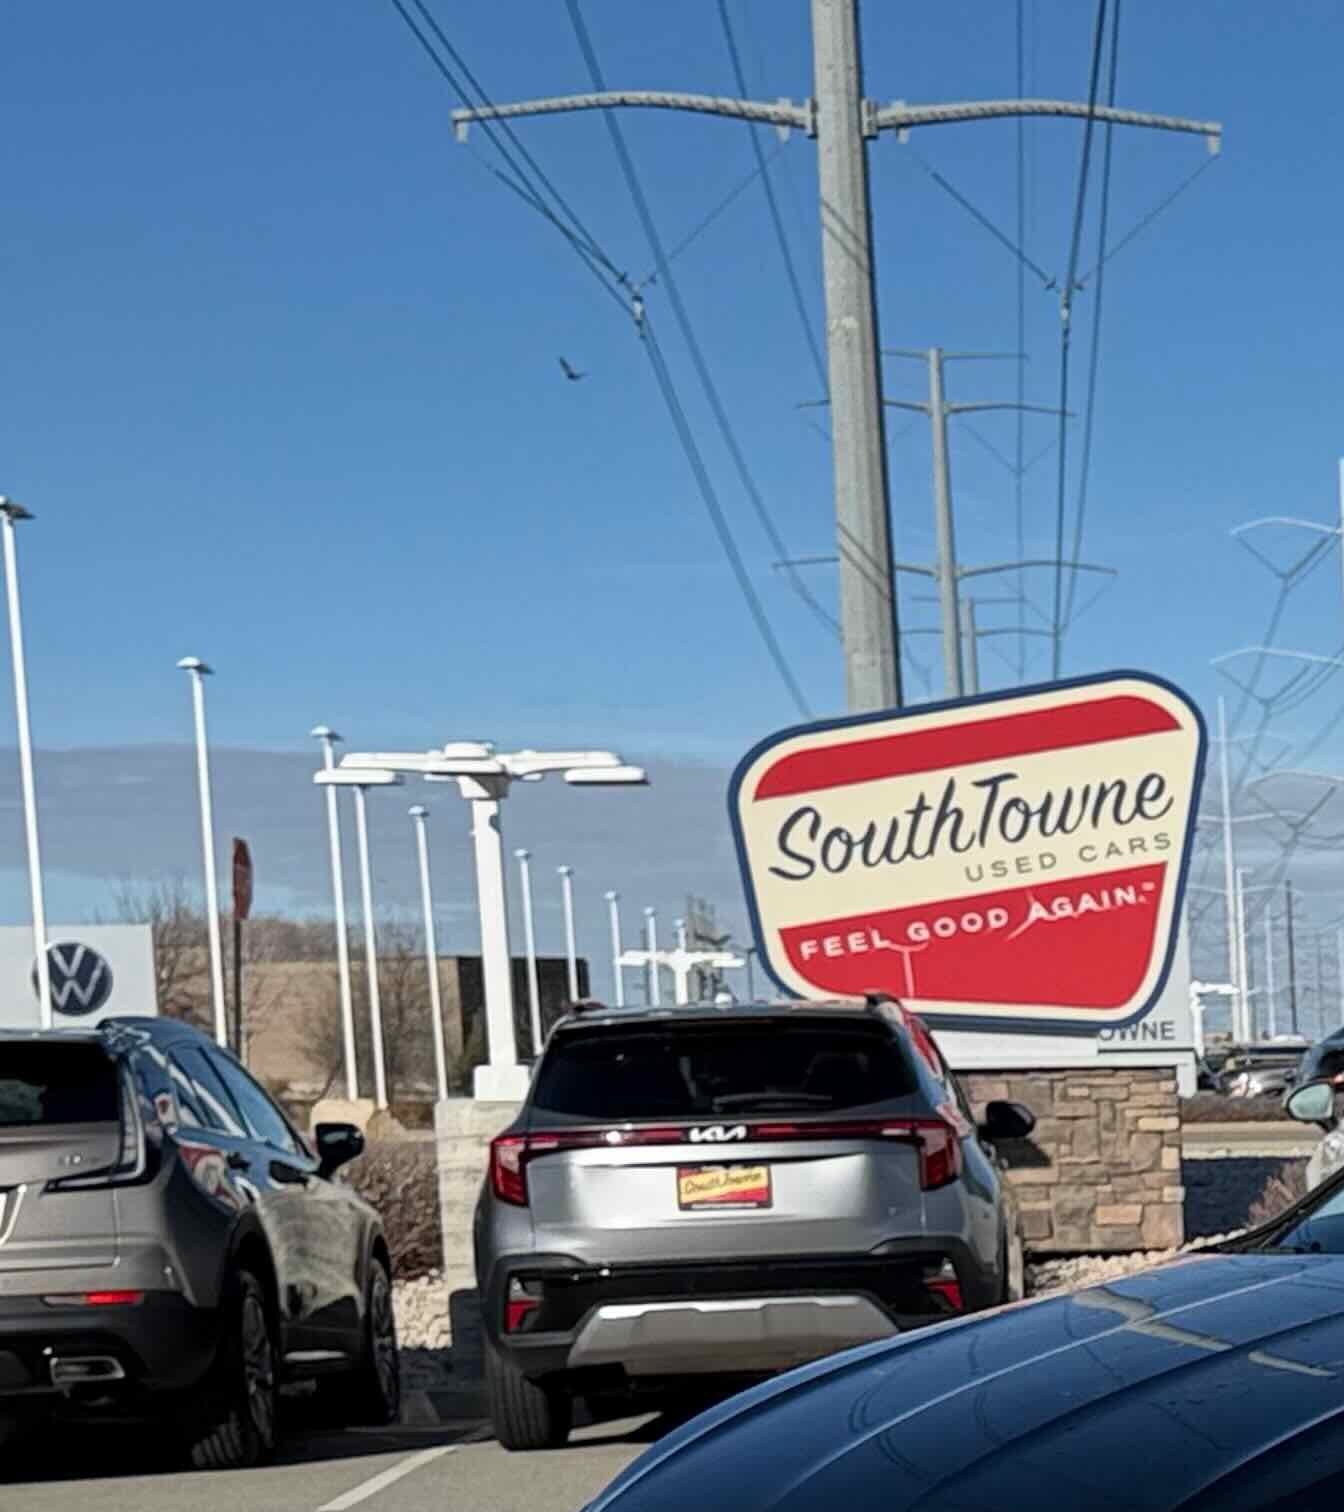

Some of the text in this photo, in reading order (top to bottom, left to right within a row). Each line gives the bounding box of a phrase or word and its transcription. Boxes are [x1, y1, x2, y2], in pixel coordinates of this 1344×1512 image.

[768, 772, 1174, 881] SouthTowne
[964, 832, 1171, 882] USED CARS
[800, 929, 889, 961] FEEL
[906, 907, 1009, 942] GOOD
